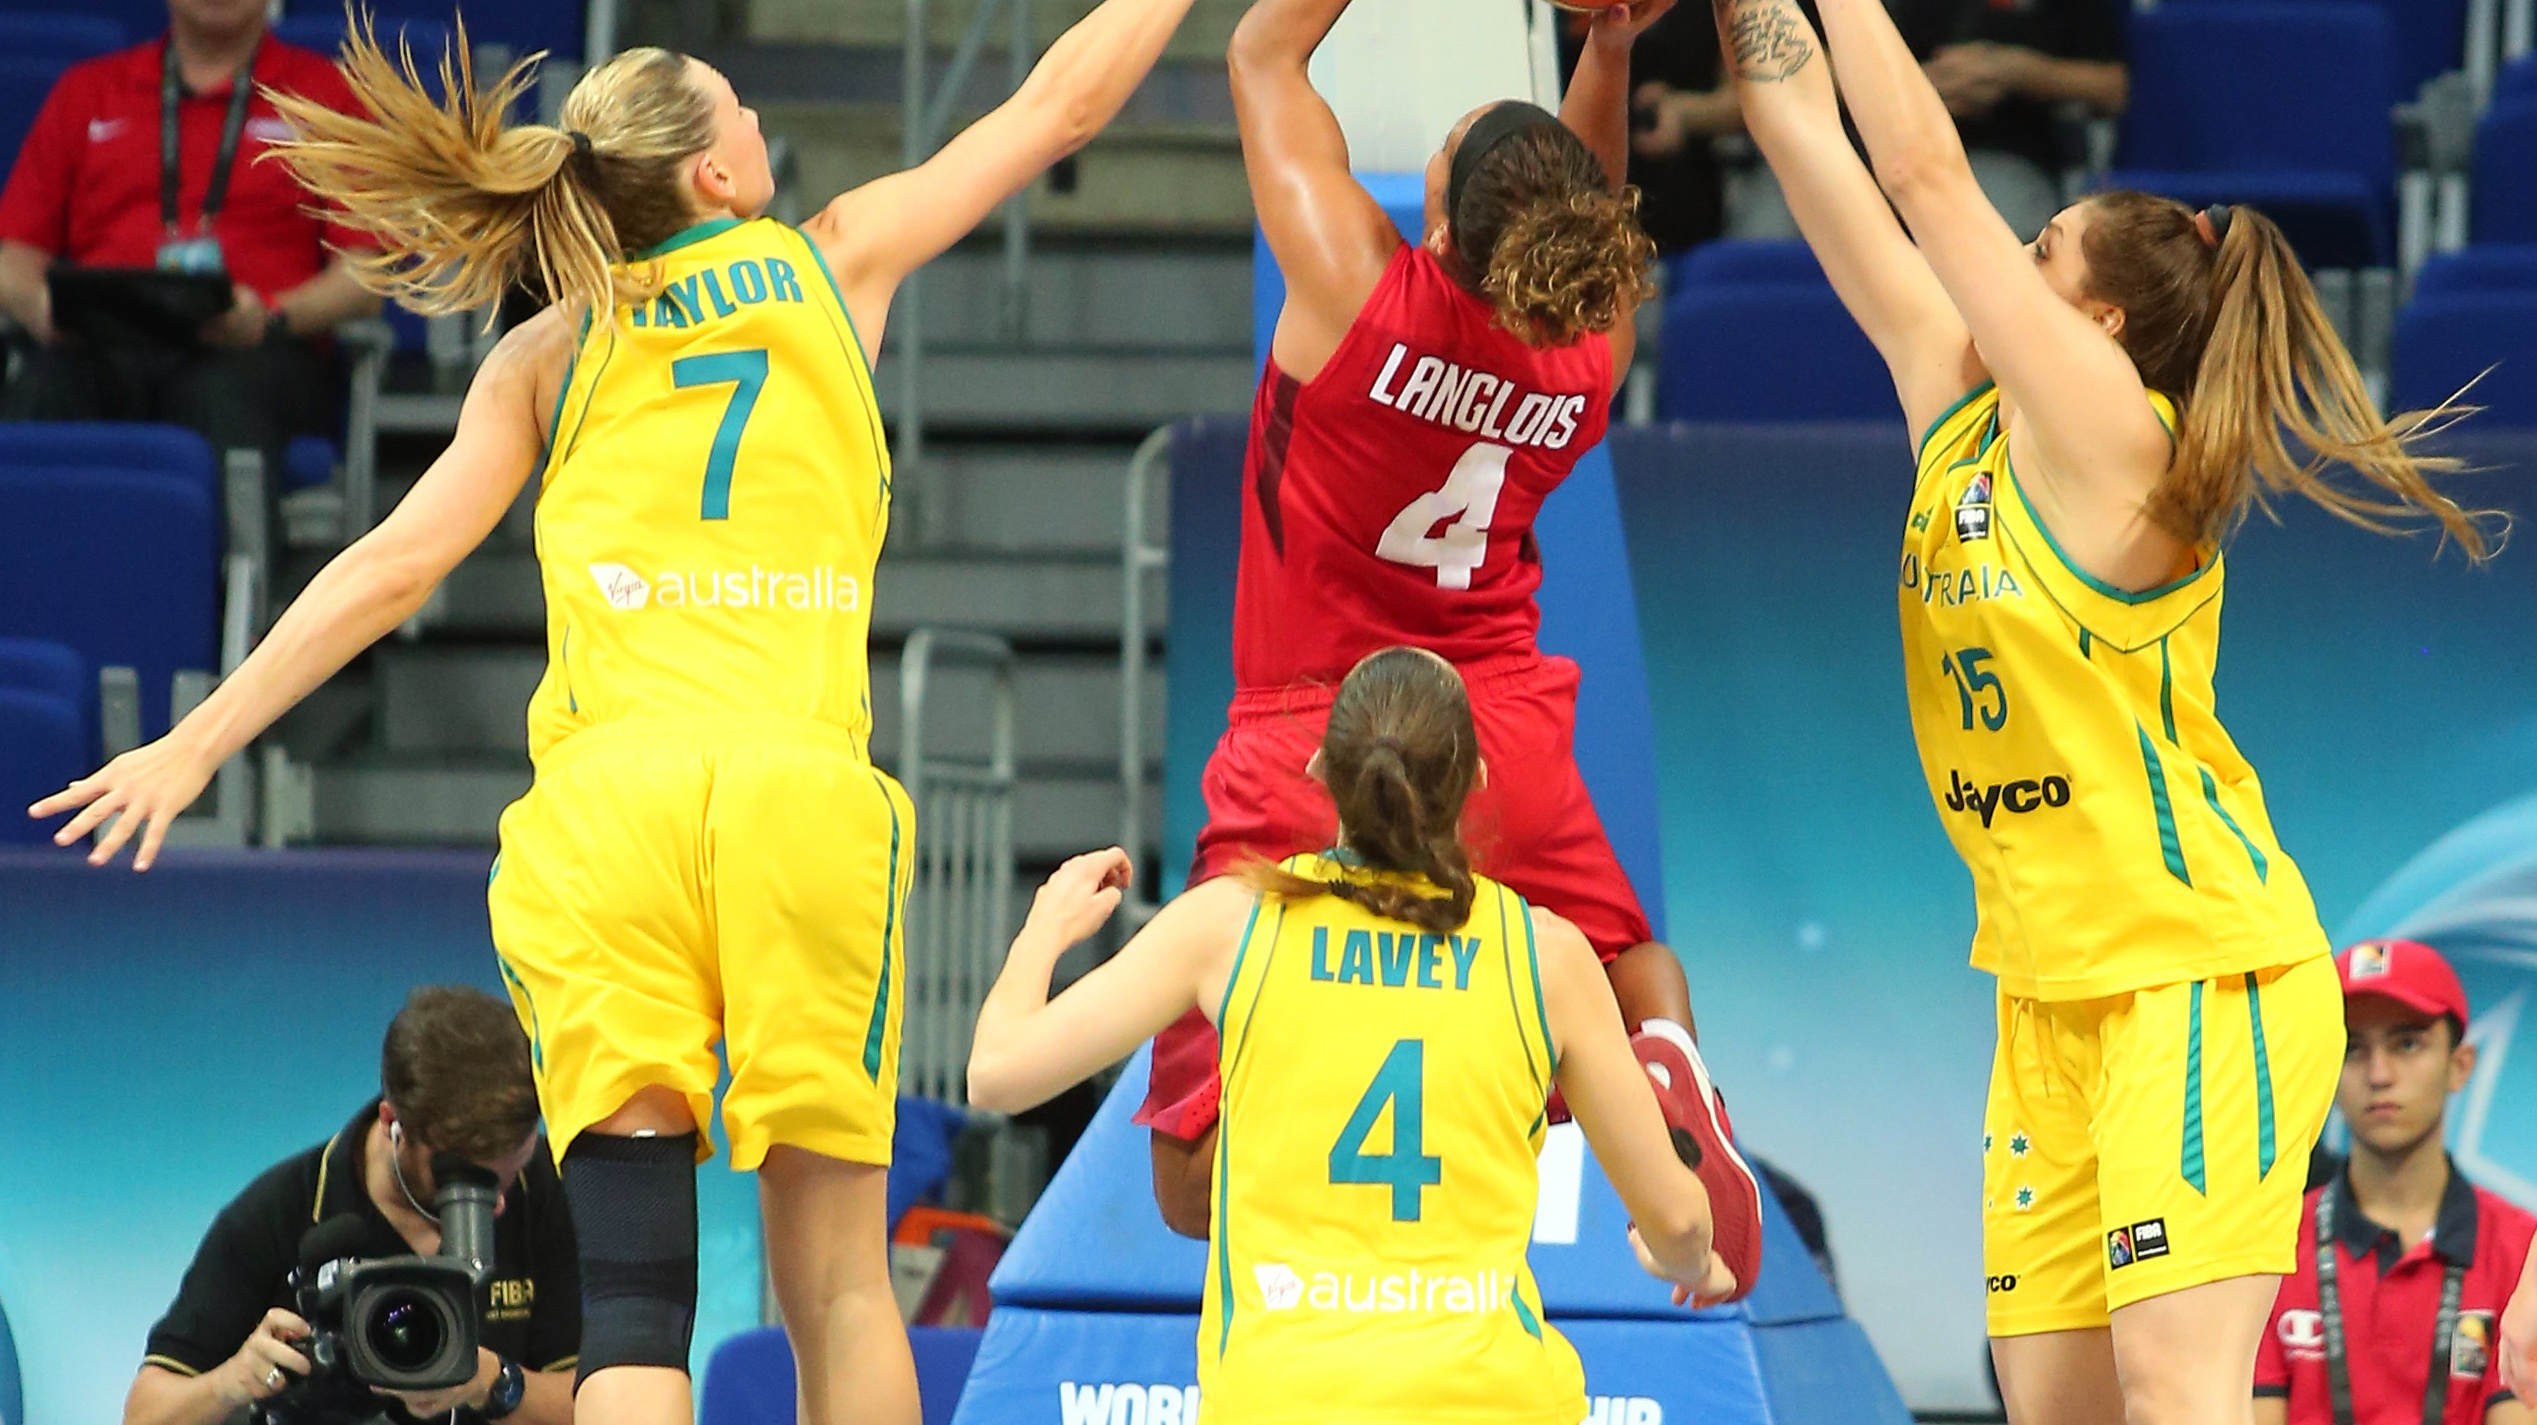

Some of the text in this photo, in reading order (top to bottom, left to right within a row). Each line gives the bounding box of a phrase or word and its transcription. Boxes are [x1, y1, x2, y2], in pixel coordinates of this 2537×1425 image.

[672, 349, 769, 520] 7
[1369, 343, 1586, 450] LANGLOIS
[1375, 441, 1514, 590] 4
[656, 564, 859, 612] australia
[1942, 647, 2008, 731] 15
[1310, 926, 1482, 991] LAVEY
[1328, 1037, 1442, 1222] 4
[2135, 1222, 2162, 1241] FIBA
